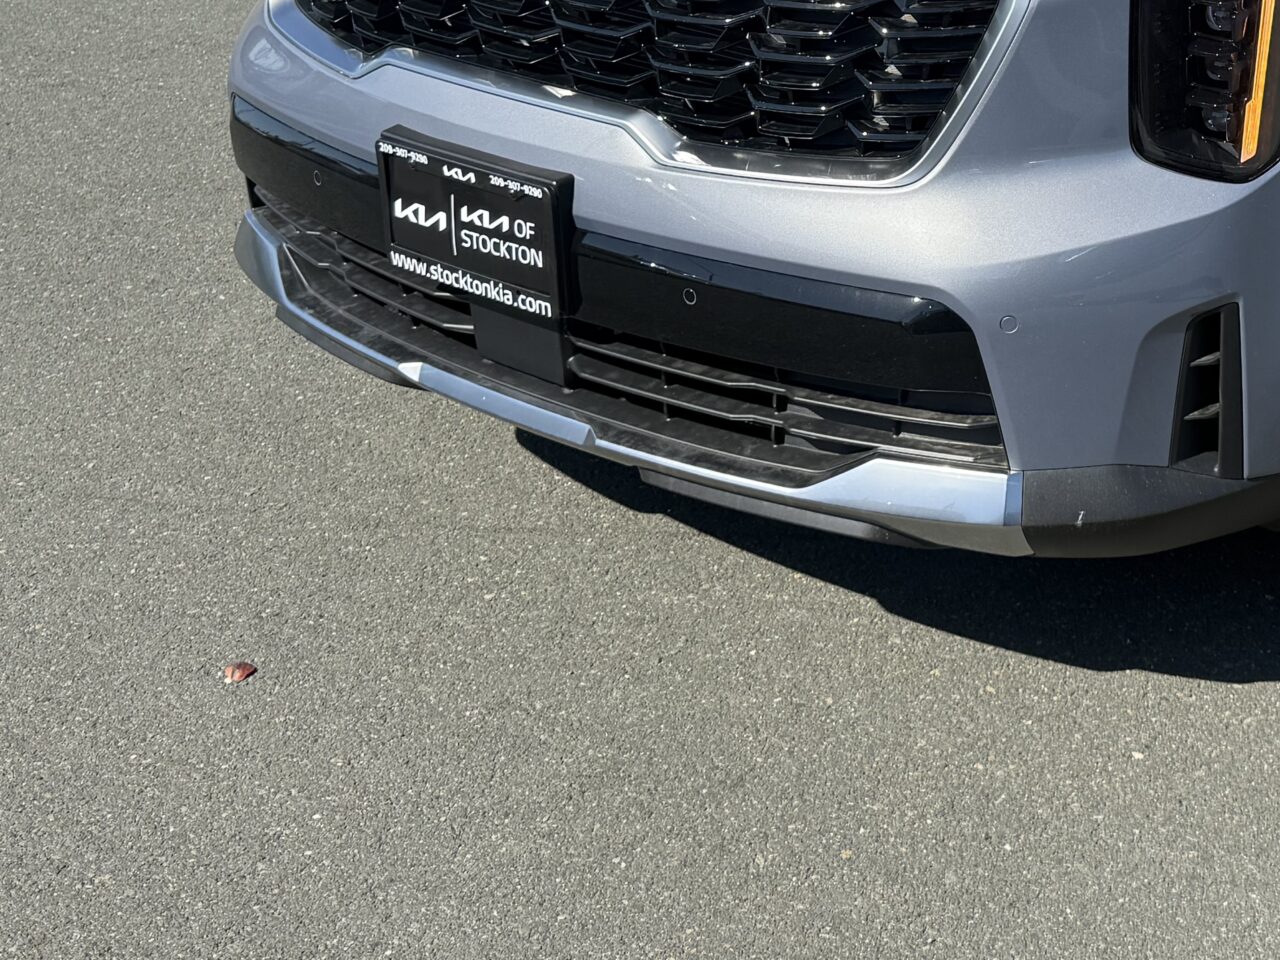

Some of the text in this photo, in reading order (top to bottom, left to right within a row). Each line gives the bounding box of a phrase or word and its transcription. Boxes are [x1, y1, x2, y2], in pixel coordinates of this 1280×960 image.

[442, 165, 475, 183] KIA
[394, 198, 447, 232] KIA
[460, 205, 535, 240] KIA OF
[460, 229, 543, 268] STOCKTON
[390, 250, 552, 318] www.stocktonkia.com
